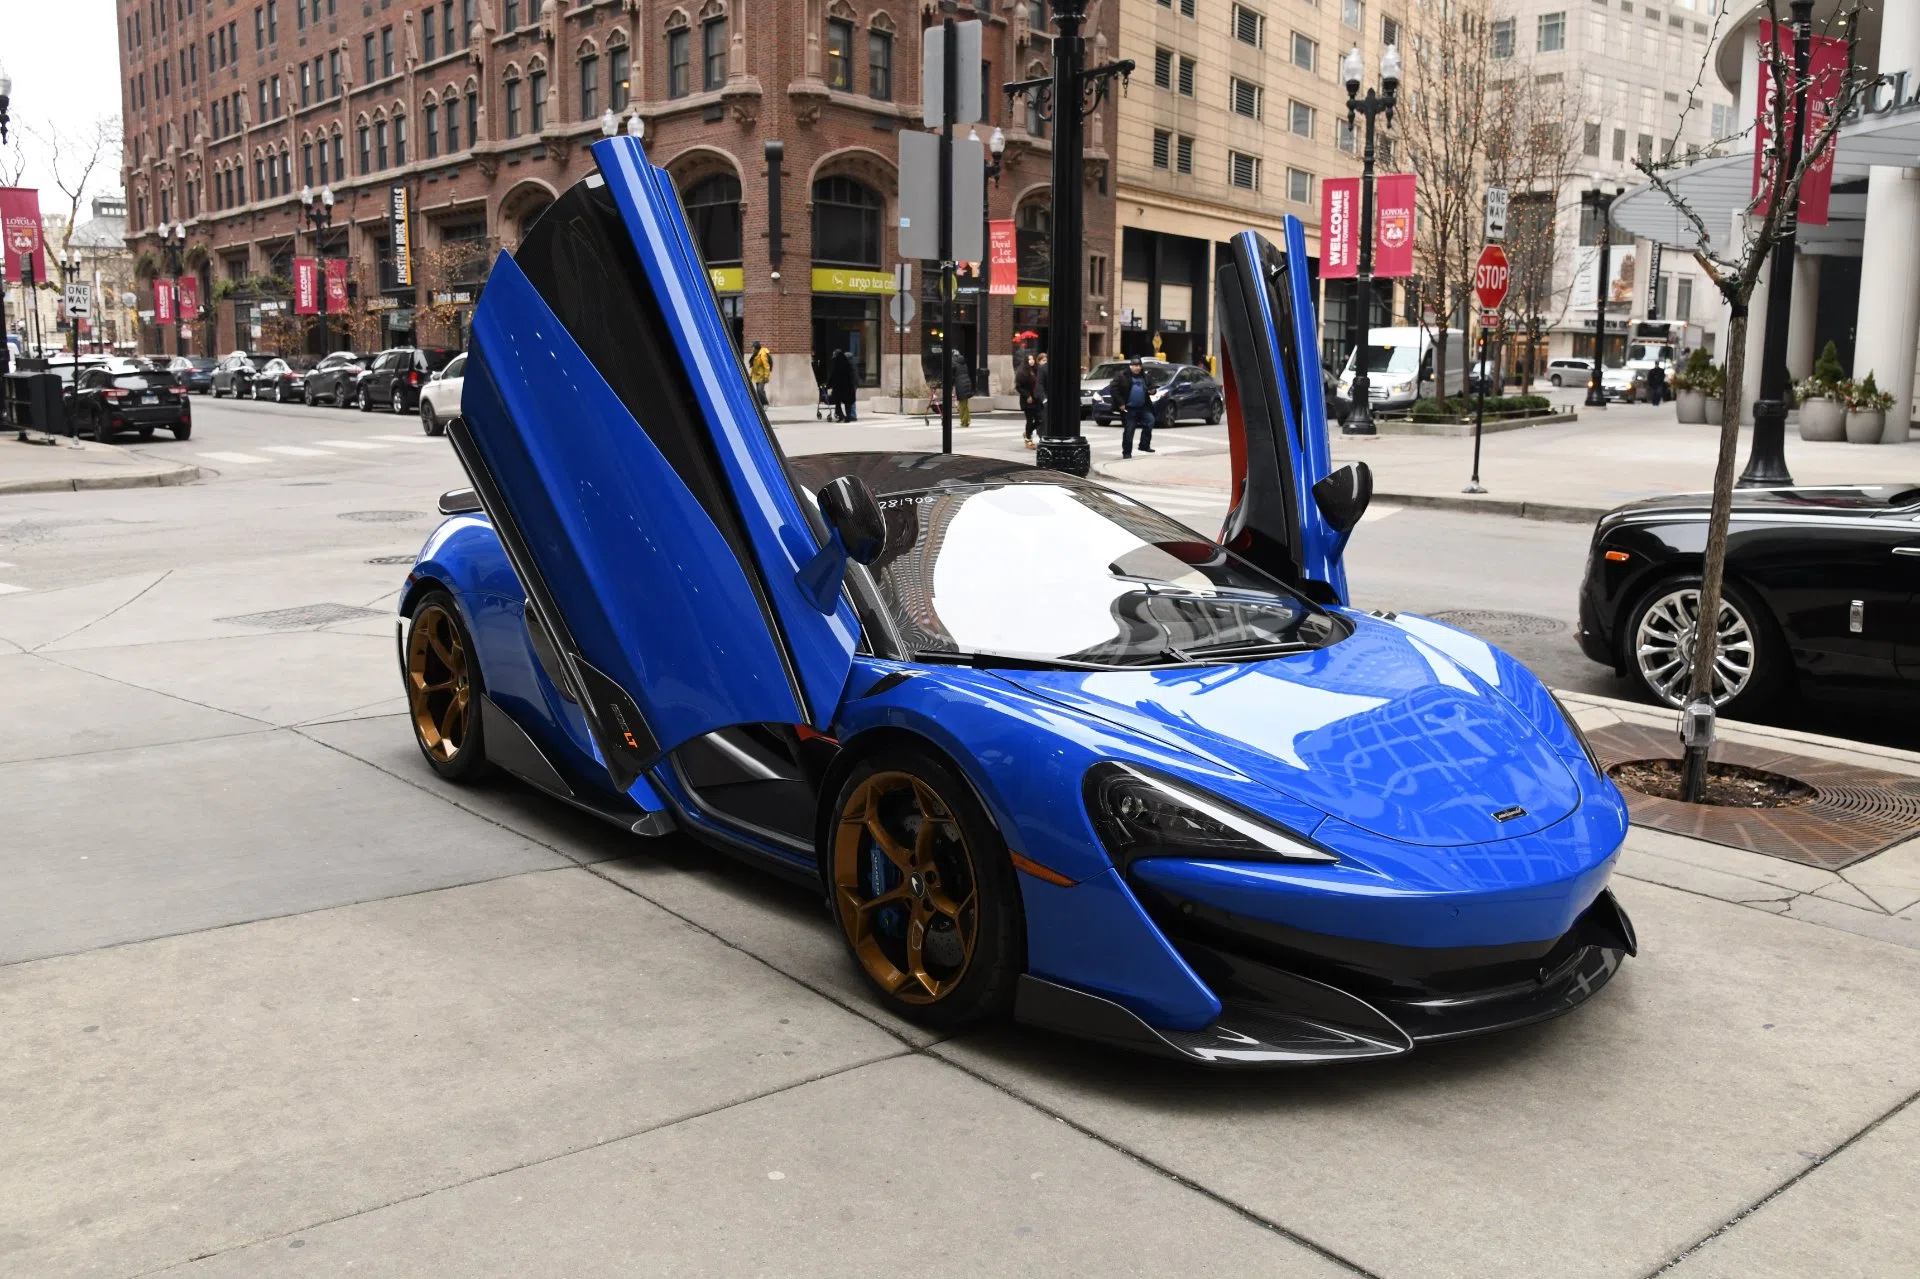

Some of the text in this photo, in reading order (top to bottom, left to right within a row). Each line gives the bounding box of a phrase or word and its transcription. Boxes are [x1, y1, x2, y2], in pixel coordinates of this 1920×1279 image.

[1874, 70, 1920, 118] CL
[394, 188, 405, 220] BAGELS
[1490, 191, 1506, 204] ONE
[1381, 208, 1409, 216] LOYOLA
[1488, 206, 1505, 218] WAY
[6, 217, 36, 225] LOYOLA
[1329, 190, 1342, 267] WELCOME
[992, 240, 1011, 248] David
[1000, 248, 1012, 256] Lee
[397, 246, 407, 283] EINSTEIN
[1650, 242, 1659, 287] ORDSTROM
[713, 270, 725, 286] fé
[849, 278, 870, 291] argo
[872, 277, 883, 288] tea
[1478, 265, 1506, 289] STOP
[68, 286, 88, 295] ONE
[300, 265, 308, 307] WELCOME
[67, 295, 88, 304] WAY
